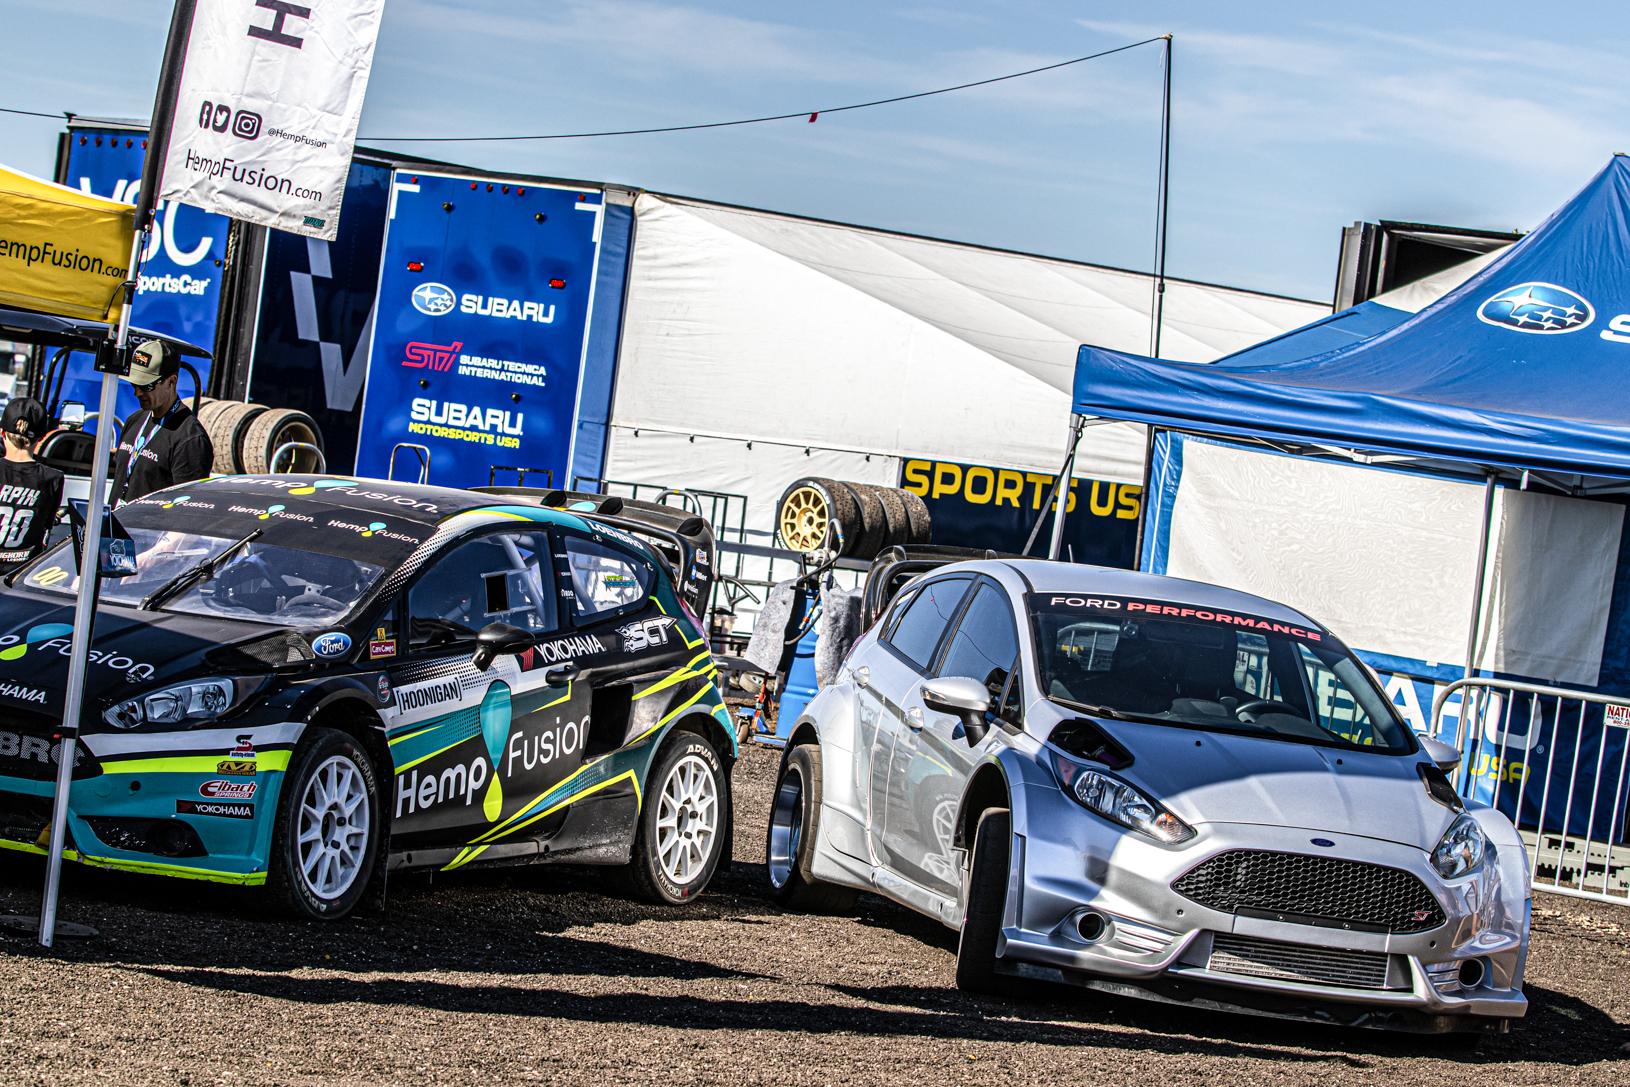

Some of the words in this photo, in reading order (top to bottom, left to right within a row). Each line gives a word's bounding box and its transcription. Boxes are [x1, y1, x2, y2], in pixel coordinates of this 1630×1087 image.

[268, 128, 327, 149] @HempFusion
[185, 148, 323, 202] HempFusion.com
[460, 293, 555, 323] SUBARU
[458, 365, 545, 387] INTERNATIONAL
[460, 355, 502, 370] SUBARU
[503, 361, 546, 376] TECNICA
[411, 398, 523, 435] SUBARU
[408, 422, 495, 445] MOTORSPORTS
[496, 434, 520, 448] USA
[904, 459, 1076, 513] SPORTS
[228, 505, 267, 515] Hemp
[272, 511, 314, 523] Fusion
[327, 519, 369, 532] Hemp
[374, 529, 420, 545] Fusion
[618, 615, 676, 653] SCT
[1051, 597, 1121, 609] FORD
[1127, 602, 1321, 641] PERFORMANCE
[534, 634, 605, 664] YOKOHAMA
[1607, 705, 1630, 718] NATI
[351, 749, 376, 796] YOKOHAMA
[686, 744, 718, 772] ADVAN
[1470, 753, 1531, 784] USA
[395, 756, 487, 818] Hemp
[195, 804, 251, 816] YOKOHAMA
